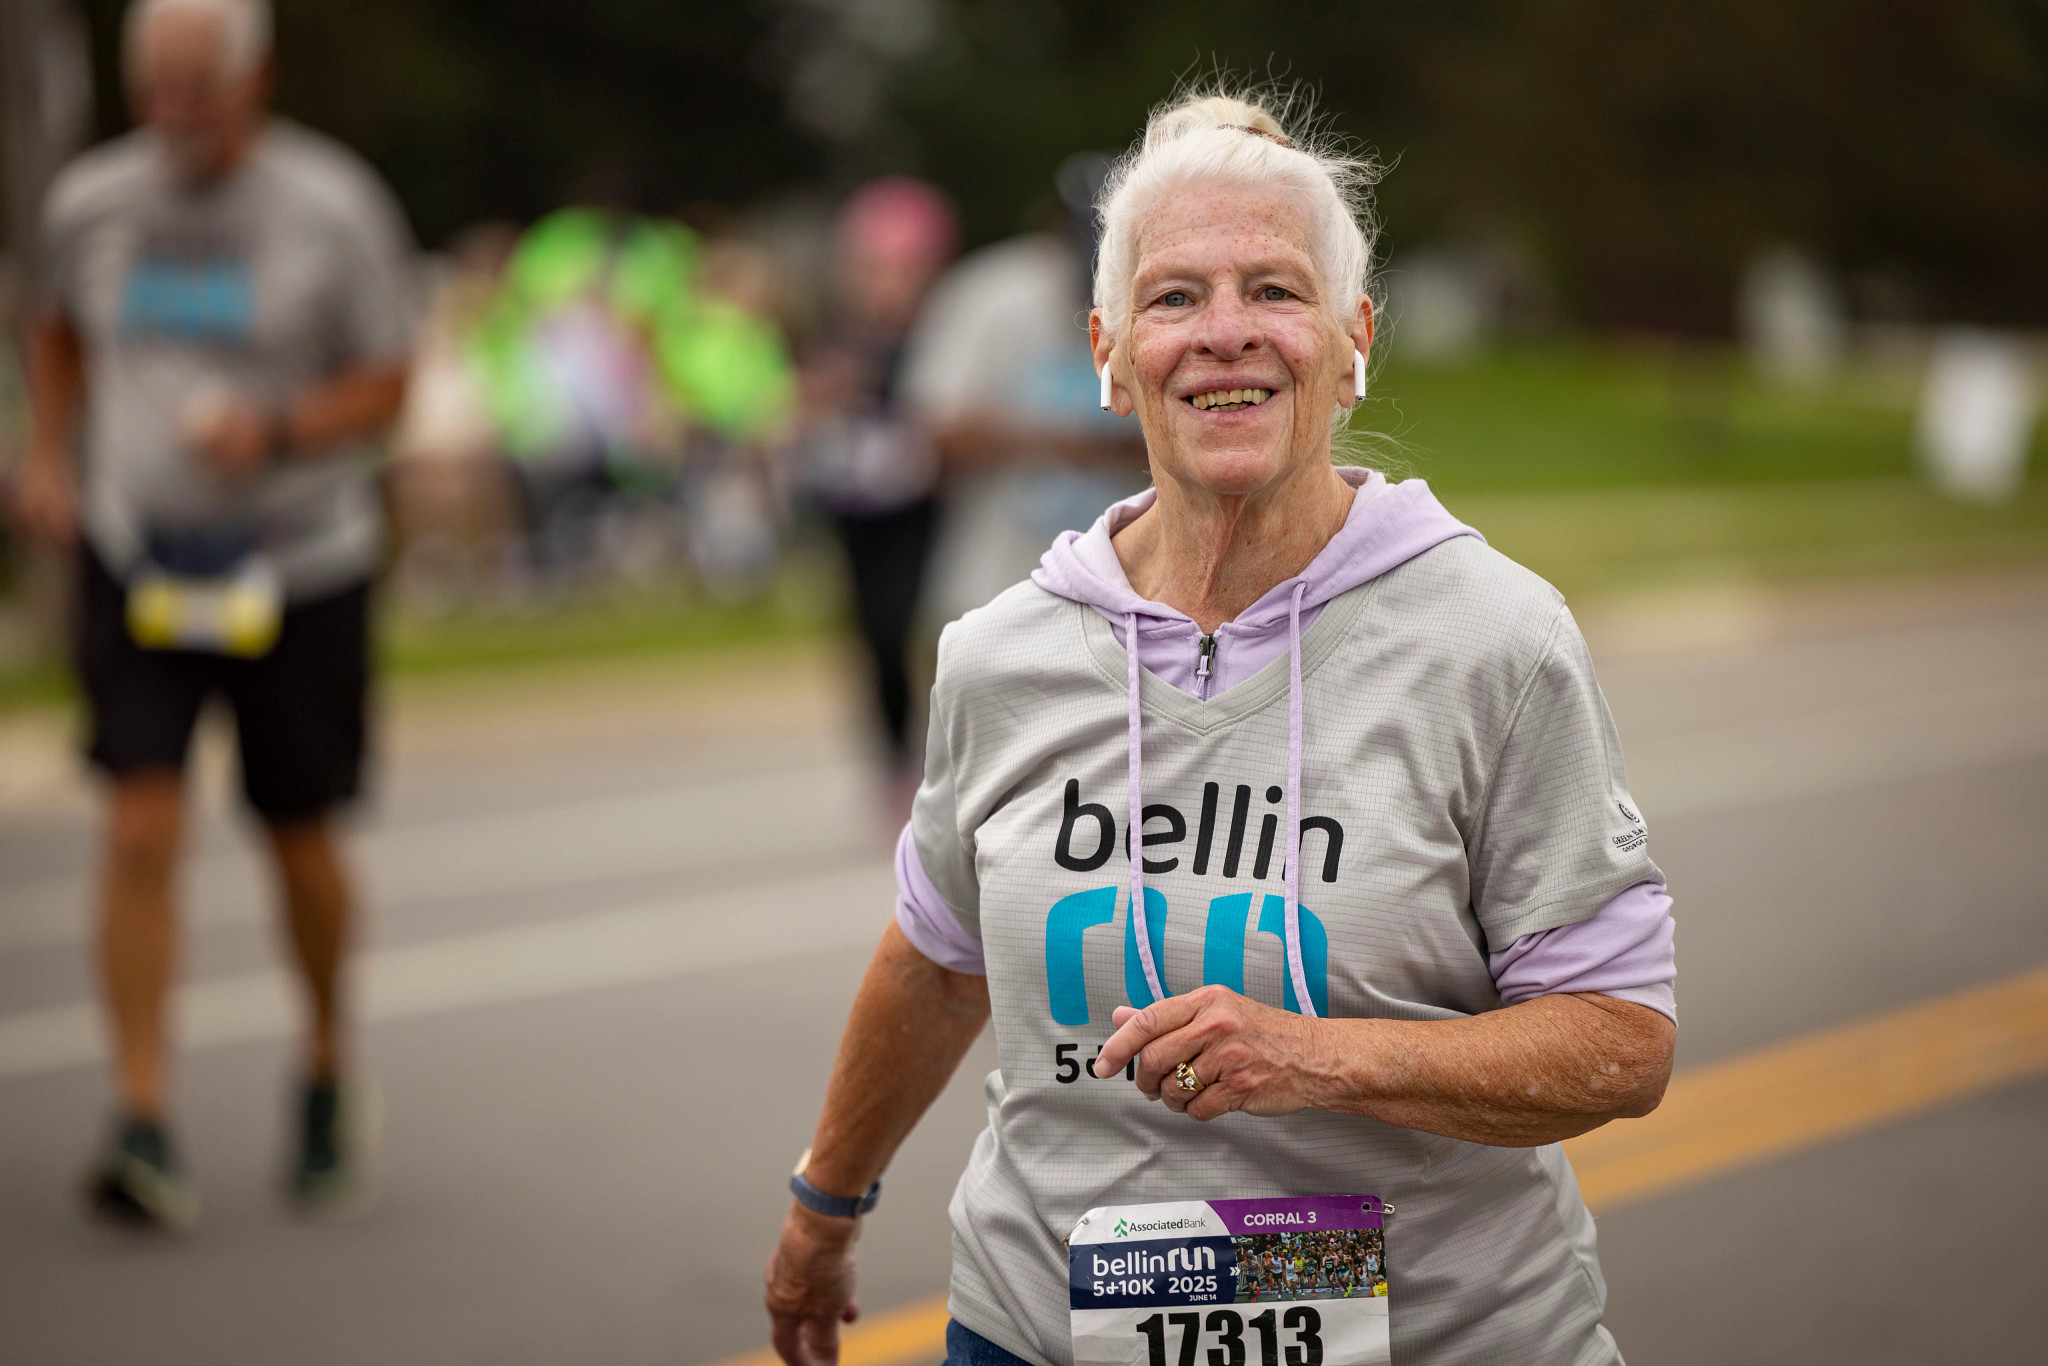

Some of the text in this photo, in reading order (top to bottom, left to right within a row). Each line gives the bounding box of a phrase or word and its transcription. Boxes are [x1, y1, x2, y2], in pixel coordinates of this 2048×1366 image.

[1054, 778, 1344, 883] bellin
[1243, 1211, 1317, 1226] CORRAL 3
[1168, 1275, 1217, 1294] 2025
[1189, 1293, 1217, 1302] JUNE 14
[1136, 1305, 1323, 1366] 17313
